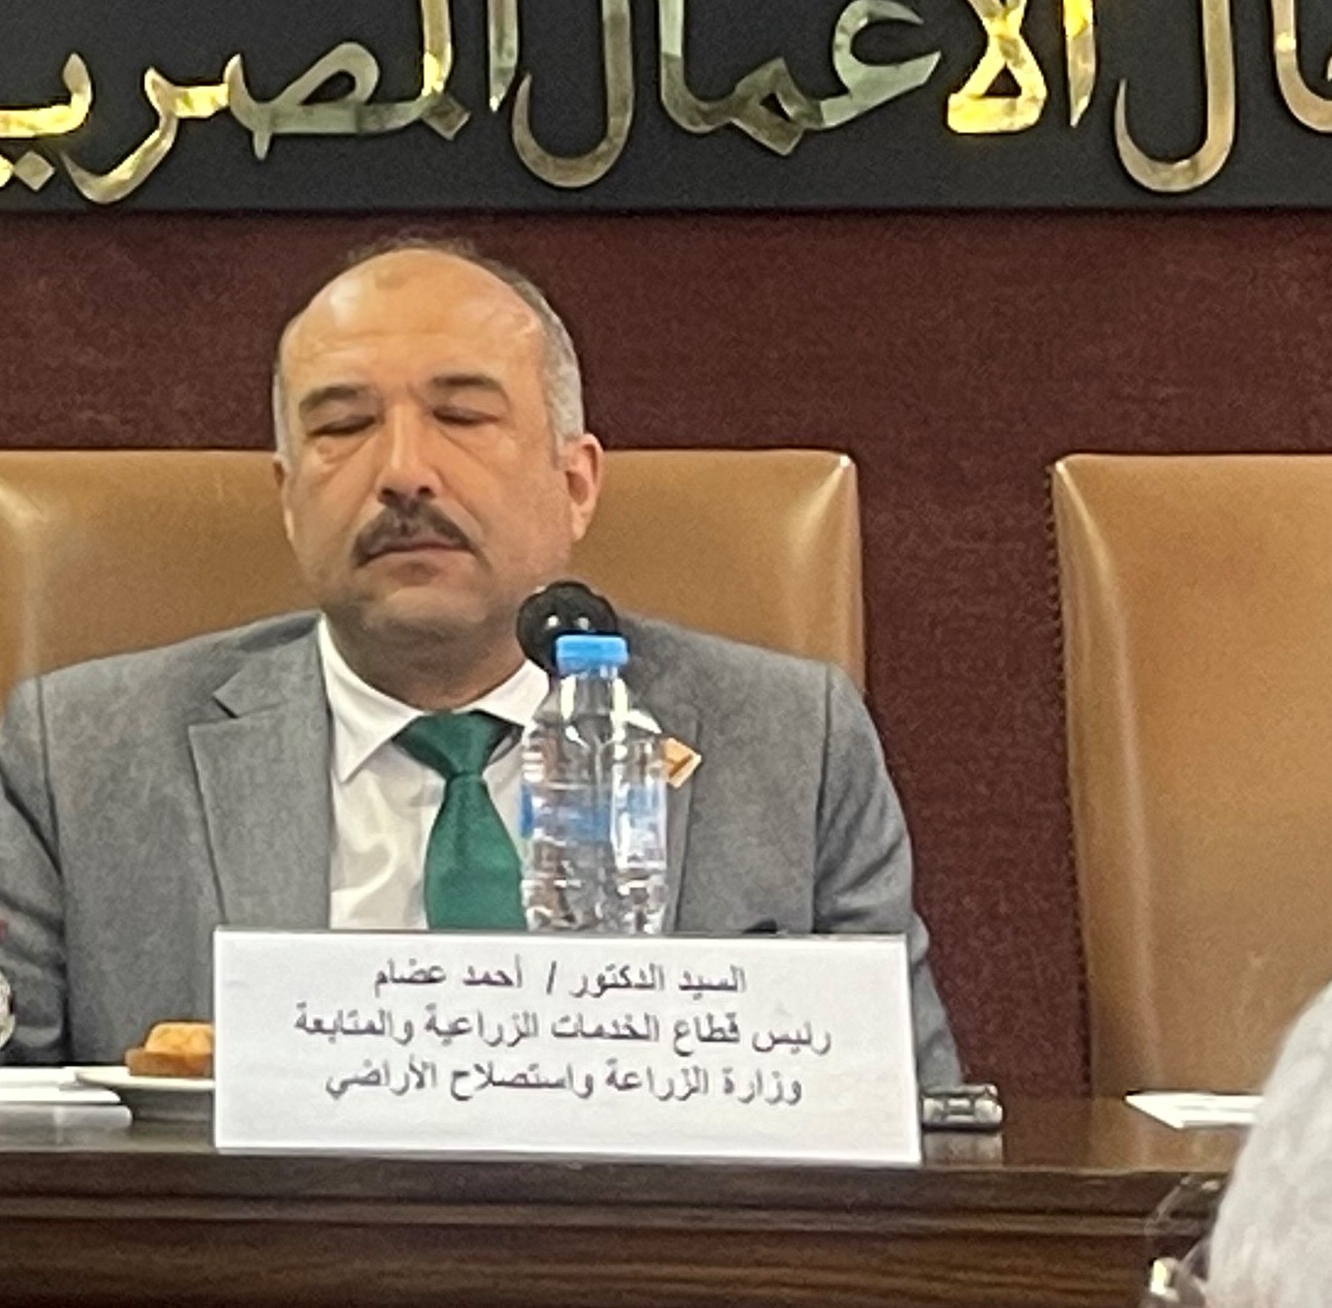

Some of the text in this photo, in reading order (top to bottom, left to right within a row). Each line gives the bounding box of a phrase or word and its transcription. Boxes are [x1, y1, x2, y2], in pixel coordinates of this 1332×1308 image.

[569, 962, 666, 999] الدكتور
[678, 963, 747, 1001] السيد
[293, 1001, 832, 1058] رئيس قطاع الخدمات الزراعية والمتابعة
[449, 1060, 595, 1102] واستصلاح
[605, 1057, 710, 1102] الزراعة
[721, 1066, 803, 1106] وزارة
